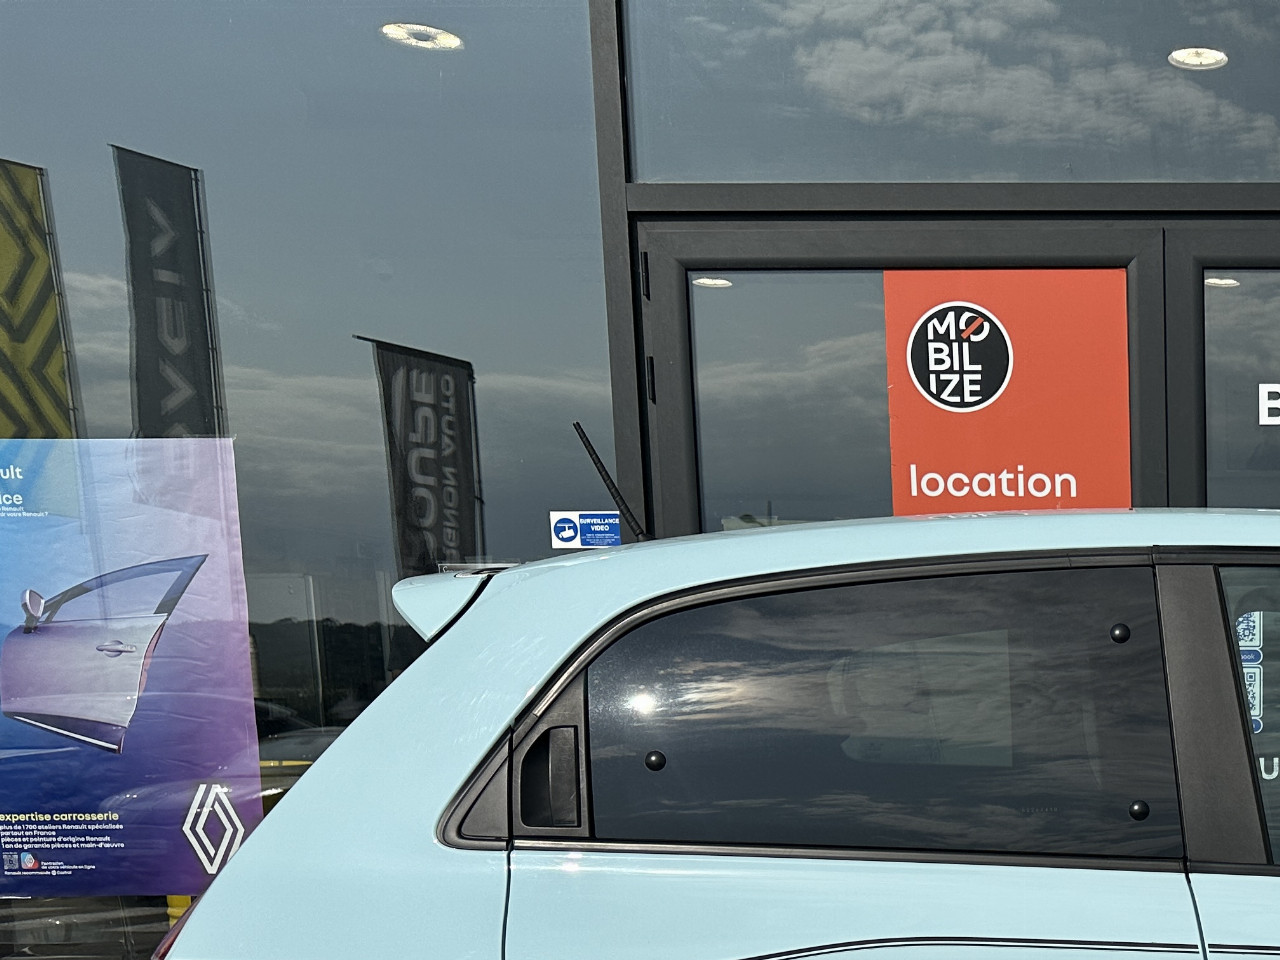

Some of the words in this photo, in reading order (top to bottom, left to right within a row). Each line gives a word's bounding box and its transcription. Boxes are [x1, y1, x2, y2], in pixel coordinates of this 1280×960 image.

[910, 464, 1077, 498] location
[1259, 757, 1279, 780] U
[0, 812, 51, 823] expertise
[53, 811, 119, 821] carrosserie
